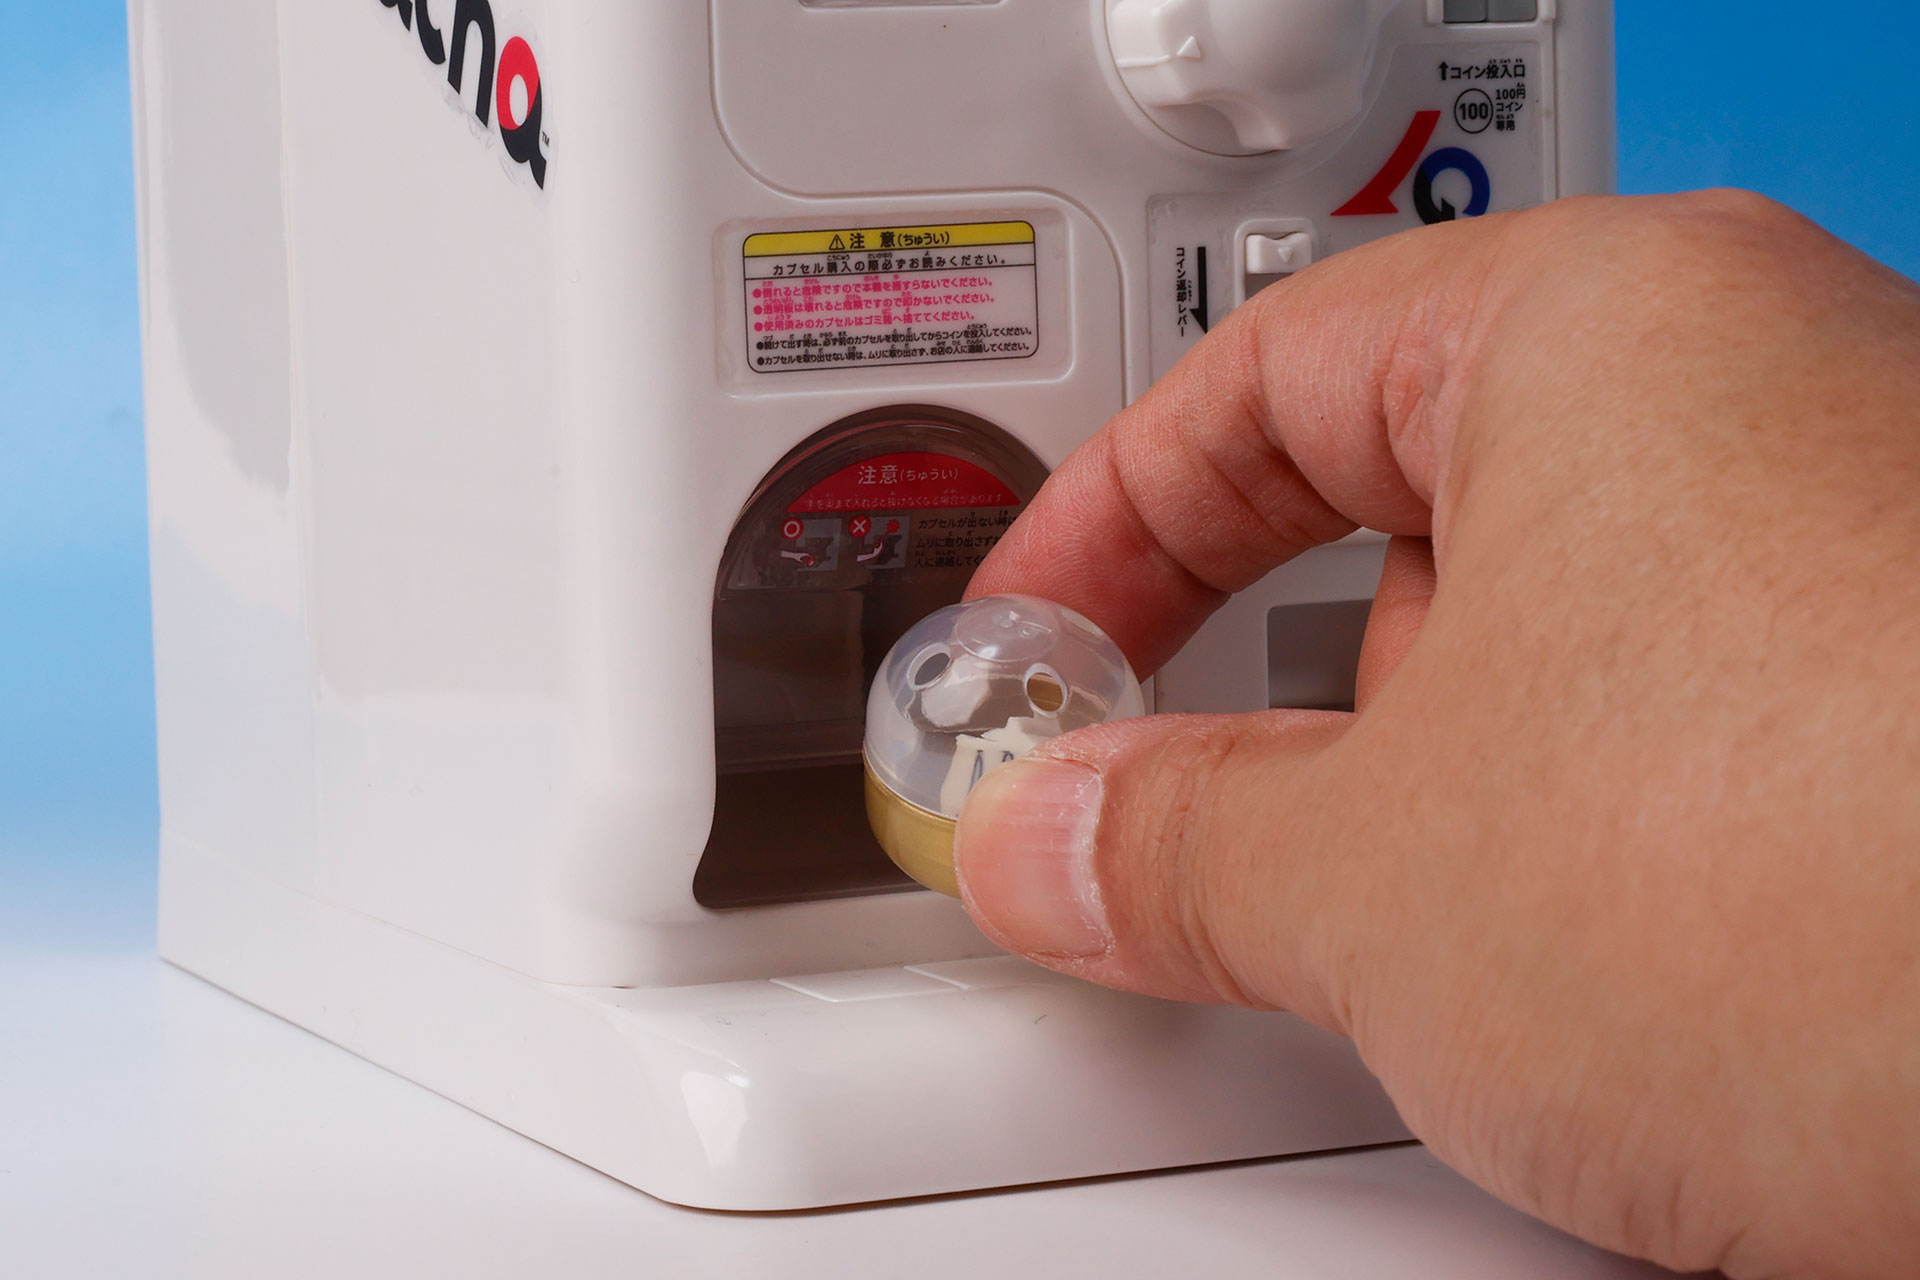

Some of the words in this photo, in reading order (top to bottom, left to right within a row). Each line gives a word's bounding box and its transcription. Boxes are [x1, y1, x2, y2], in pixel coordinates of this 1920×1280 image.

[1450, 64, 1526, 80] コイン投入口
[1495, 88, 1526, 101] 100円
[1458, 102, 1489, 121] 100
[1495, 102, 1523, 113] コイン
[1495, 120, 1515, 132] 専用
[1176, 247, 1188, 338] コイン返却レバー
[857, 464, 959, 485] 注意(ちゅうい)
